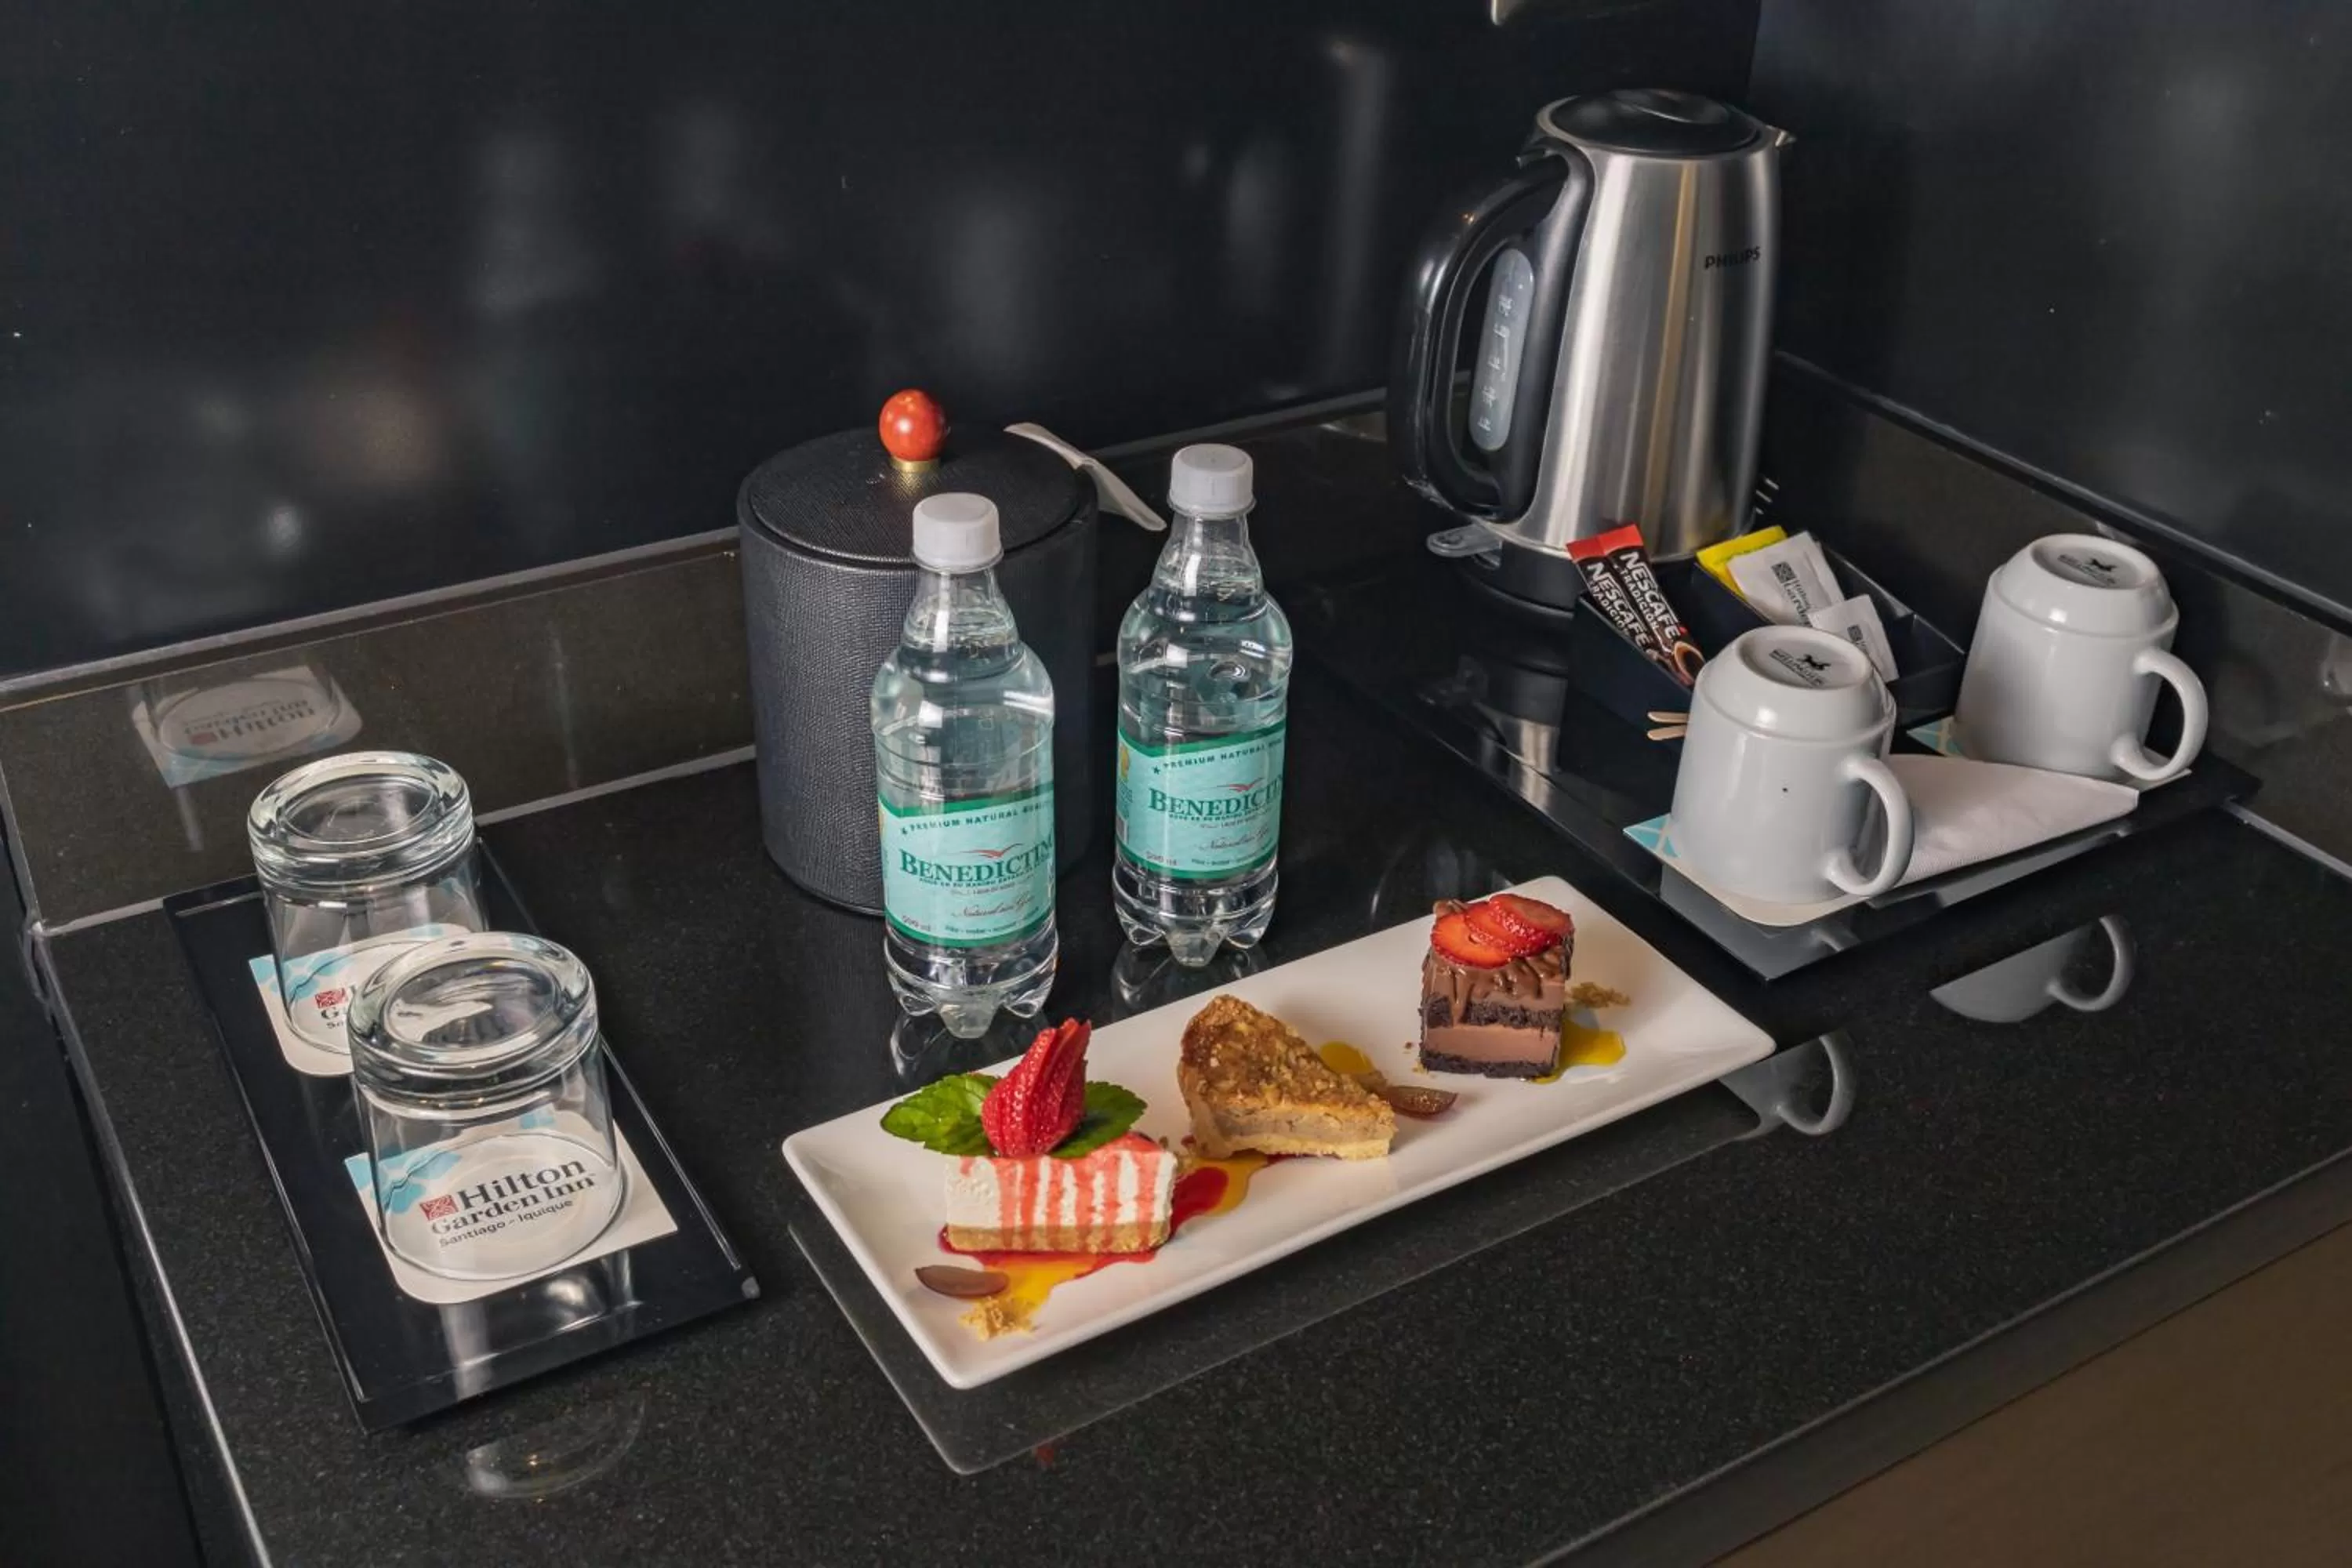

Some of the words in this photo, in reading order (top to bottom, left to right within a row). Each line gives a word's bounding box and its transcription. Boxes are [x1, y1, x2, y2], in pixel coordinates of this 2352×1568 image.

[1704, 245, 1761, 270] PHILIPS
[966, 810, 1018, 825] NATURAL
[432, 1192, 541, 1235] Garden
[543, 1176, 595, 1200] Inn
[458, 1160, 586, 1210] Hilton
[439, 1220, 506, 1247] Santiago
[517, 1197, 574, 1222] Iquique
